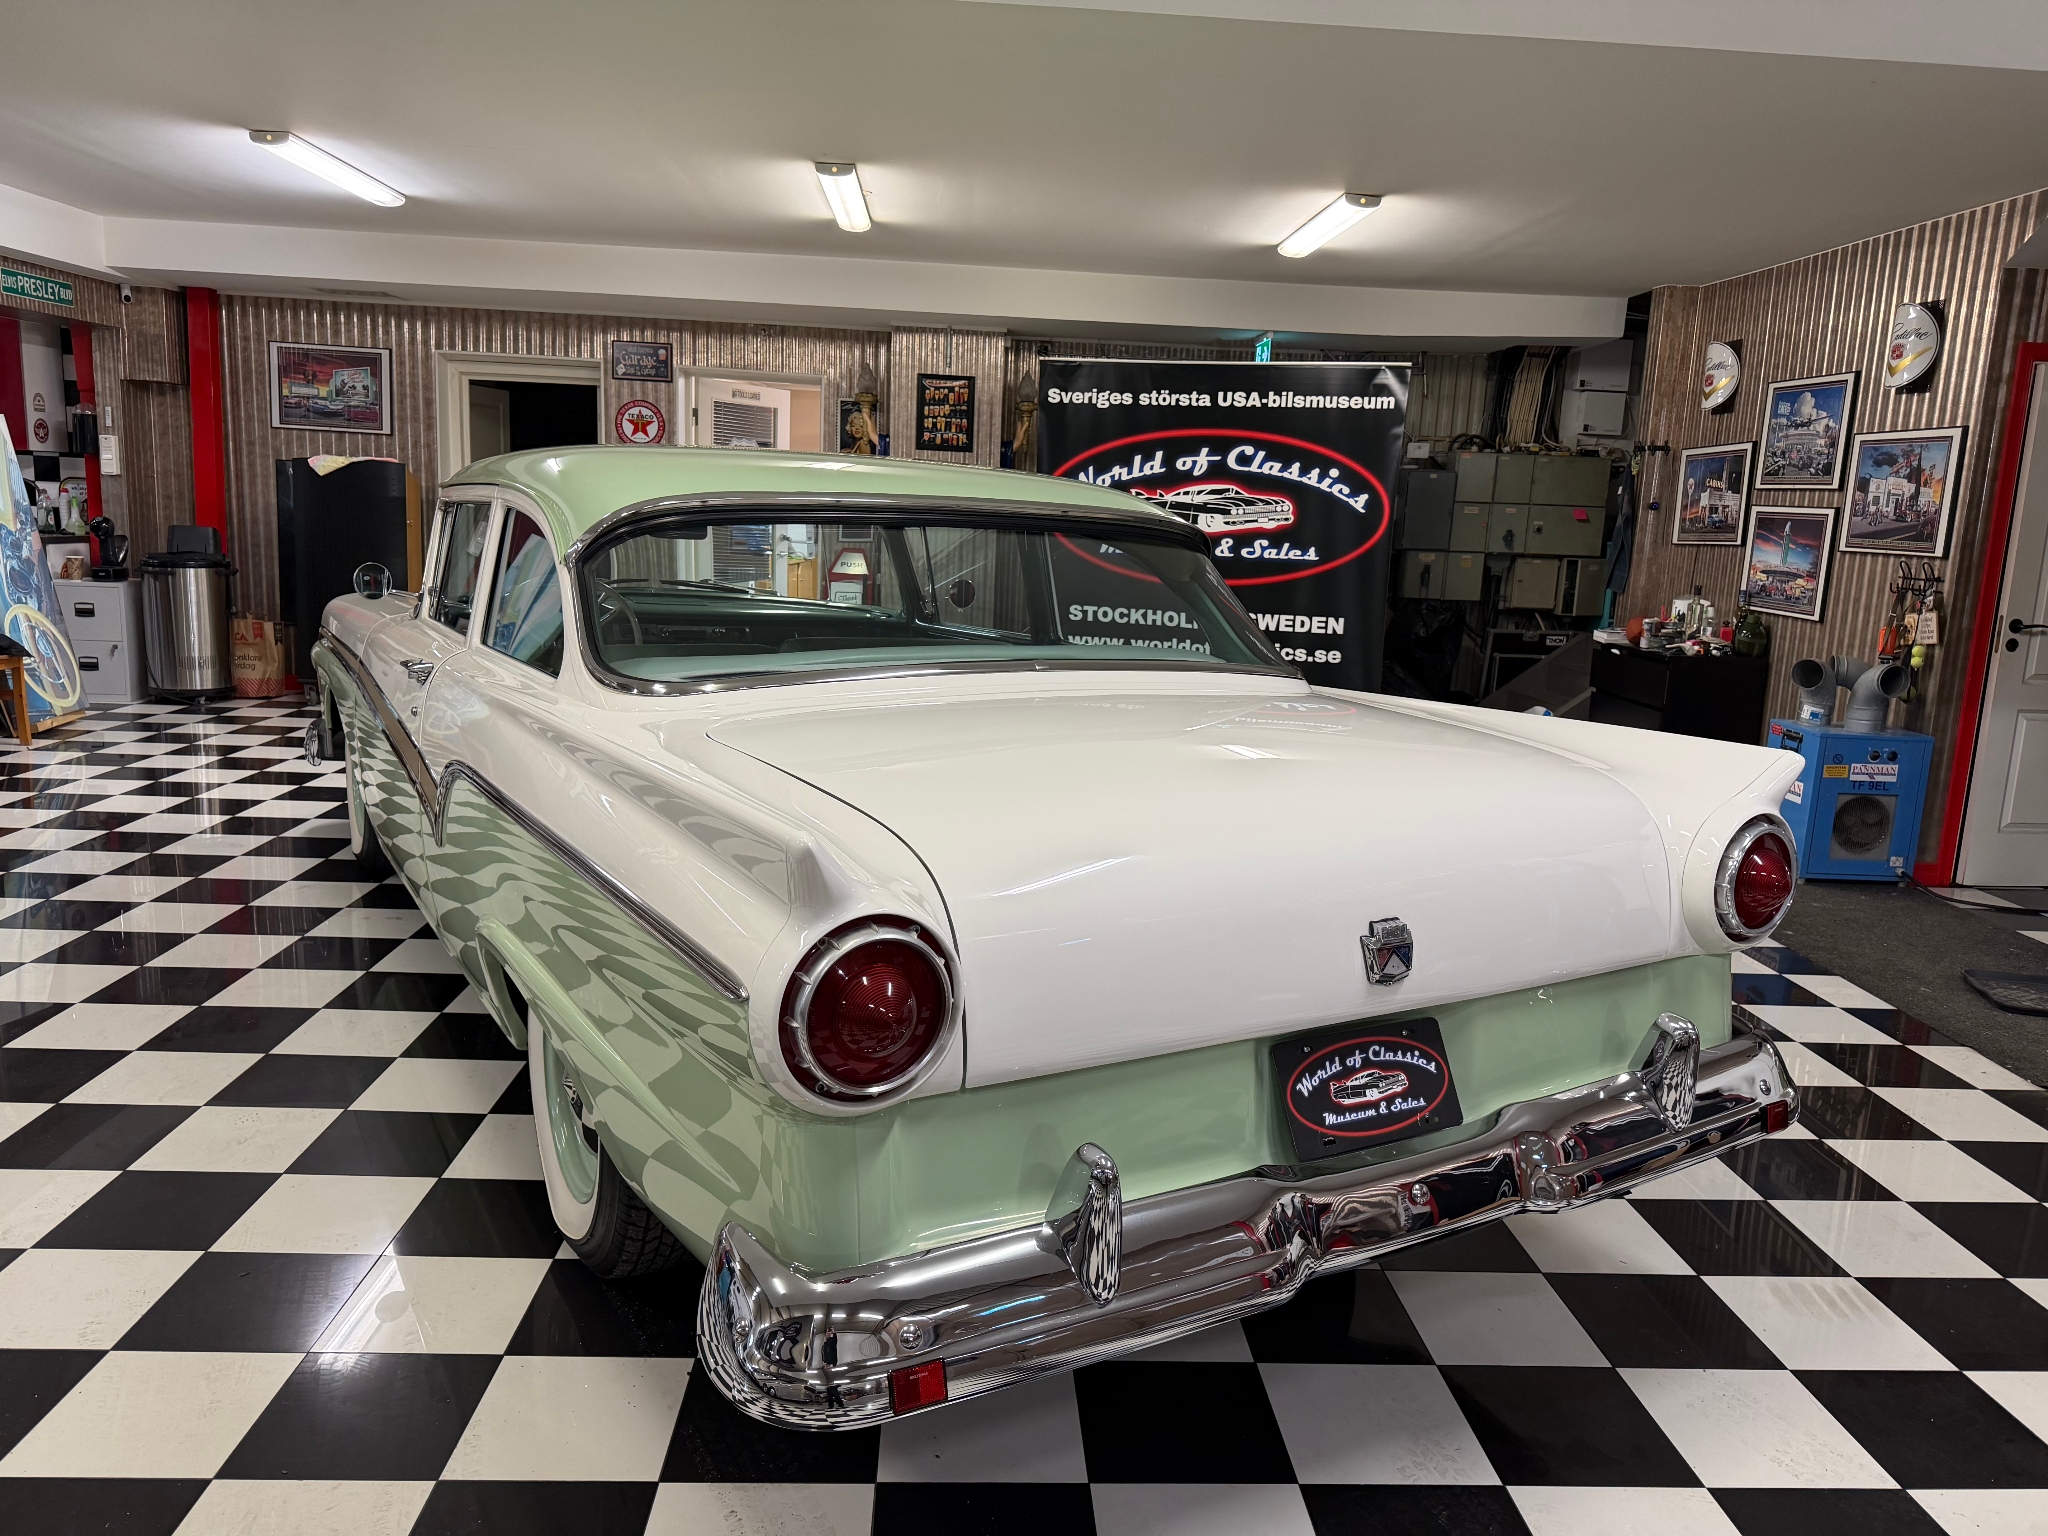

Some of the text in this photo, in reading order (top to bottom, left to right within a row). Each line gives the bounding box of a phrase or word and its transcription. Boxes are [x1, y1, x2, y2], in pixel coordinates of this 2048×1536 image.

[2, 274, 73, 301] ELVIS PRESLEY BLVD
[1047, 388, 1396, 410] Sveriges största USA-bilsmuseum
[1175, 447, 1222, 476] of
[1227, 445, 1369, 513] Classics
[1214, 538, 1320, 561] & Sales
[840, 561, 864, 569] PUSH
[1852, 765, 1897, 774] PANNMAN
[1851, 780, 1890, 791] TF 9EL
[1296, 1045, 1438, 1098] World of Classics
[1323, 1097, 1427, 1126] Museum & Sales
